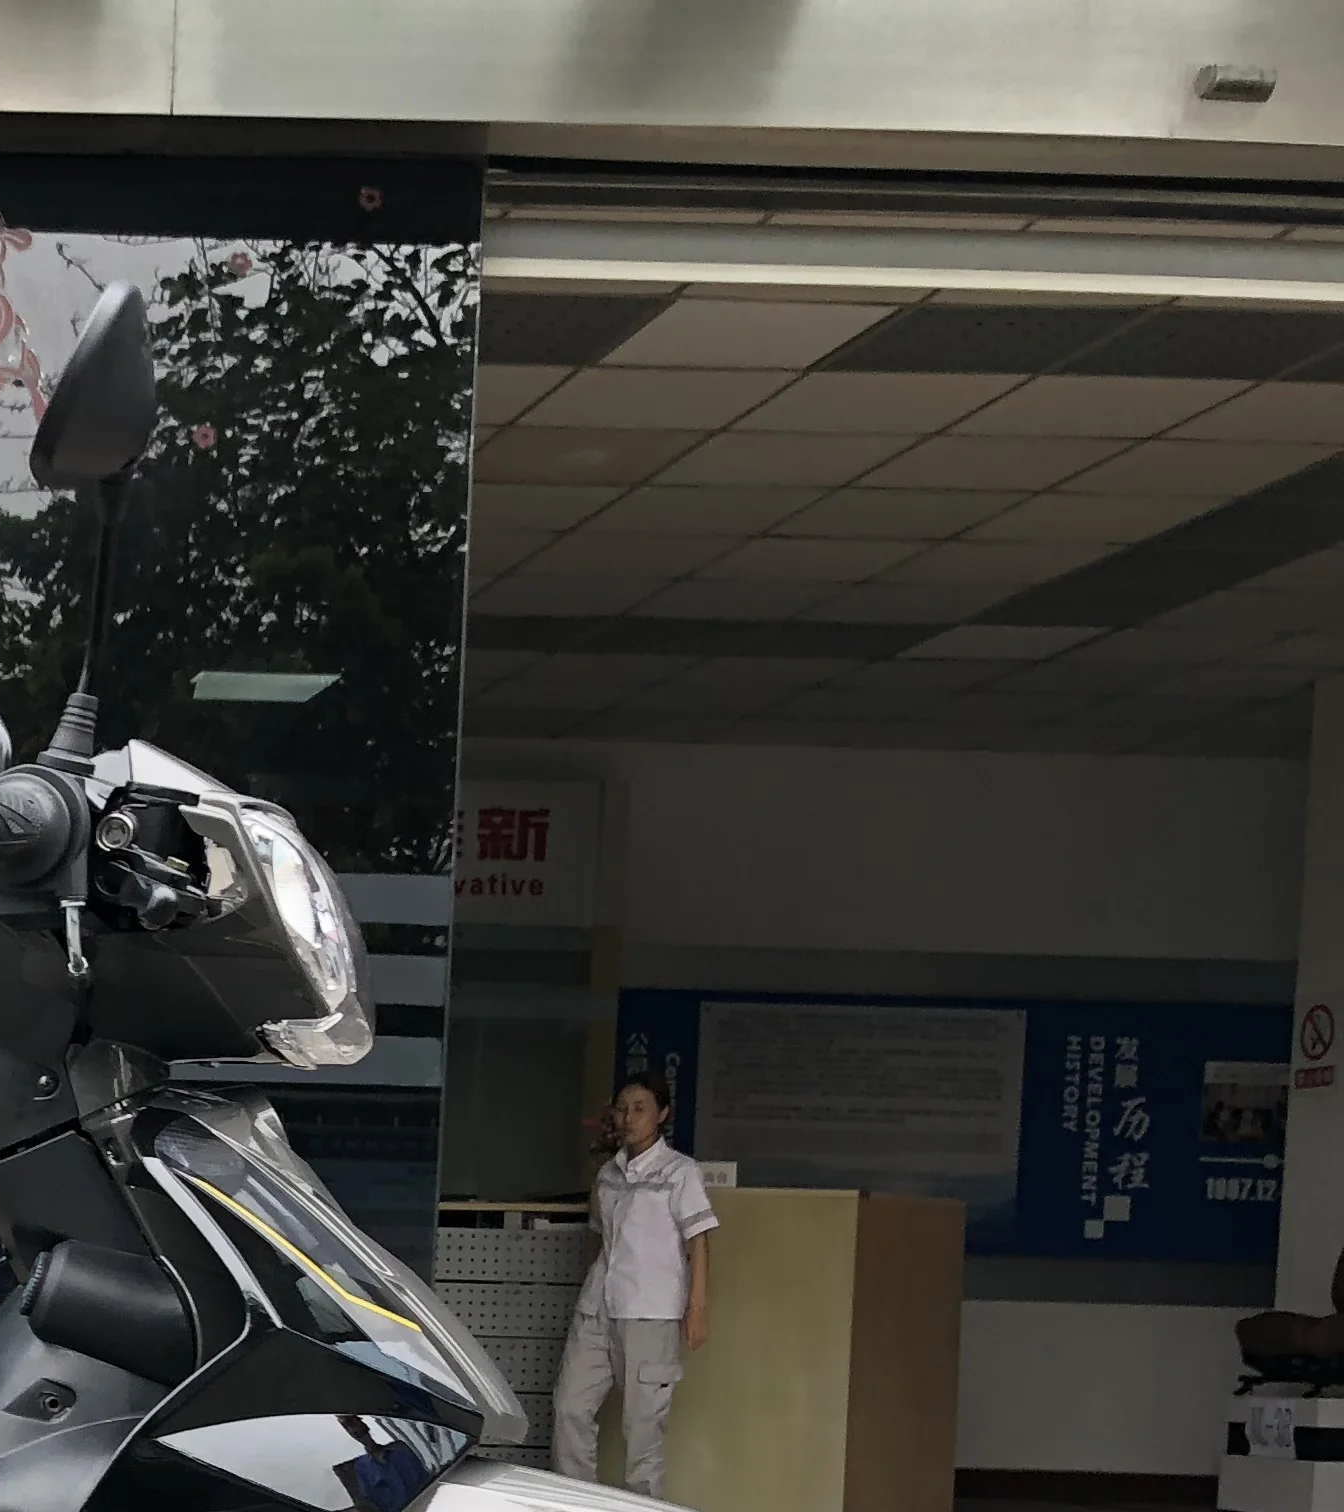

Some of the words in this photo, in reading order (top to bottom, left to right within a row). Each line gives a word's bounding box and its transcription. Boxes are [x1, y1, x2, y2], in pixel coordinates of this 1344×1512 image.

[456, 806, 550, 861] 新
[1063, 1036, 1082, 1132] HISTORY
[1081, 1036, 1106, 1206] DEVELOPMENT
